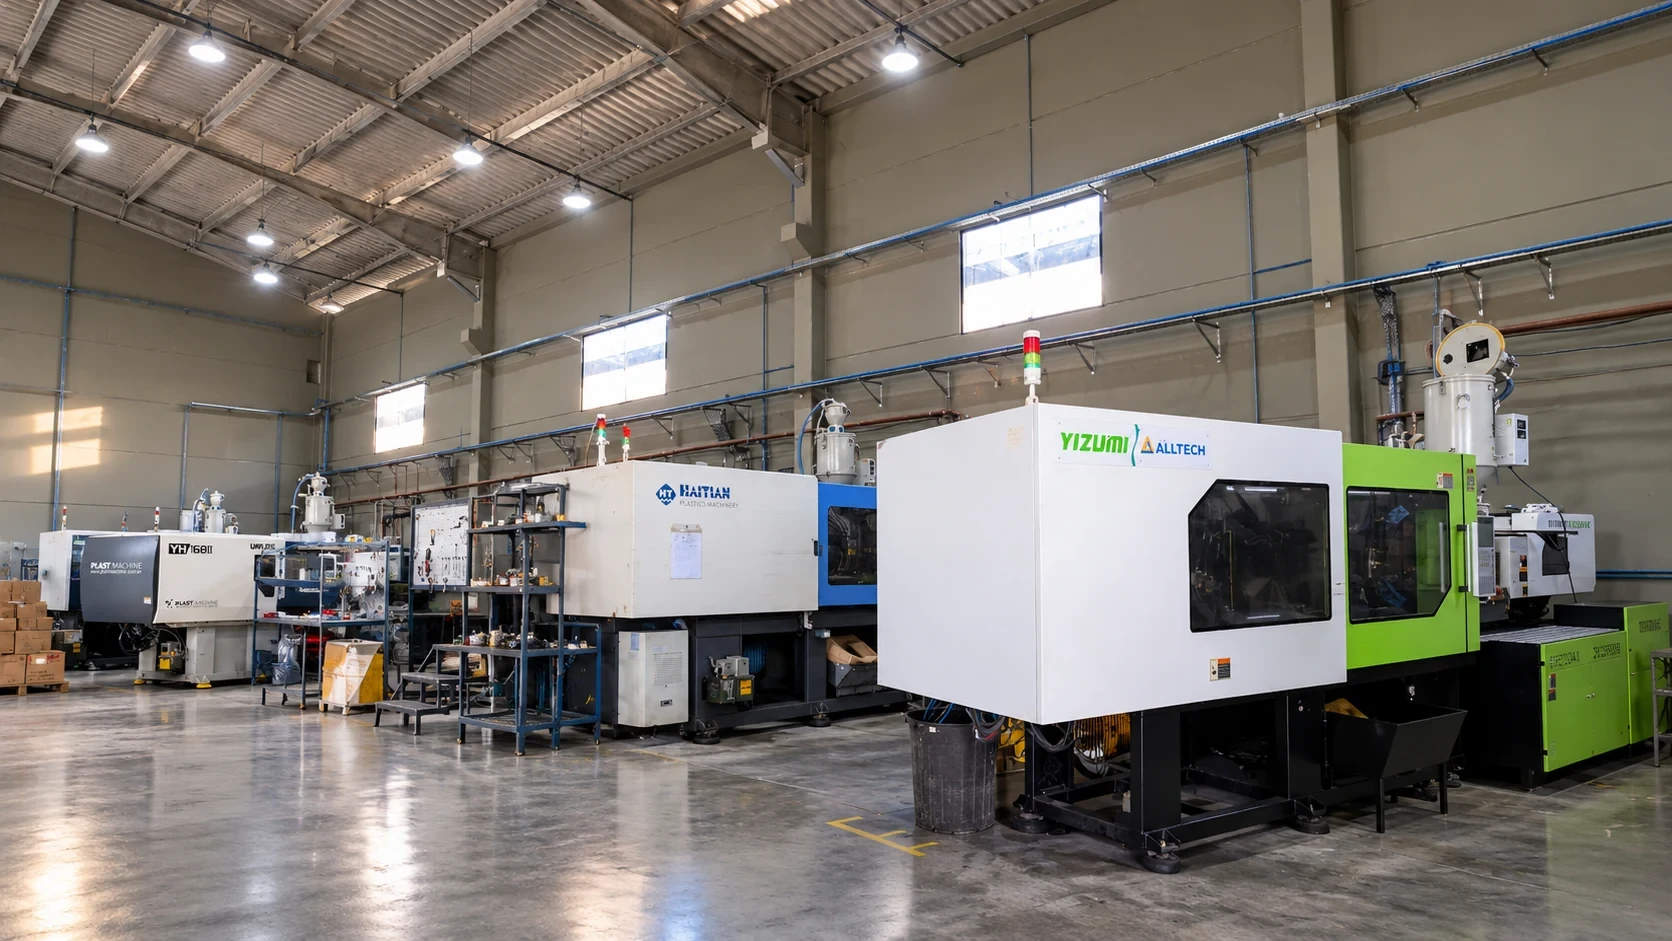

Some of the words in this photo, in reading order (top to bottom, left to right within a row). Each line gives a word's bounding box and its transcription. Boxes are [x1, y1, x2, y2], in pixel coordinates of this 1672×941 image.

[1060, 432, 1129, 454] YIZUMI
[1156, 442, 1206, 456] ALLTECH
[680, 484, 730, 499] HAITIAN
